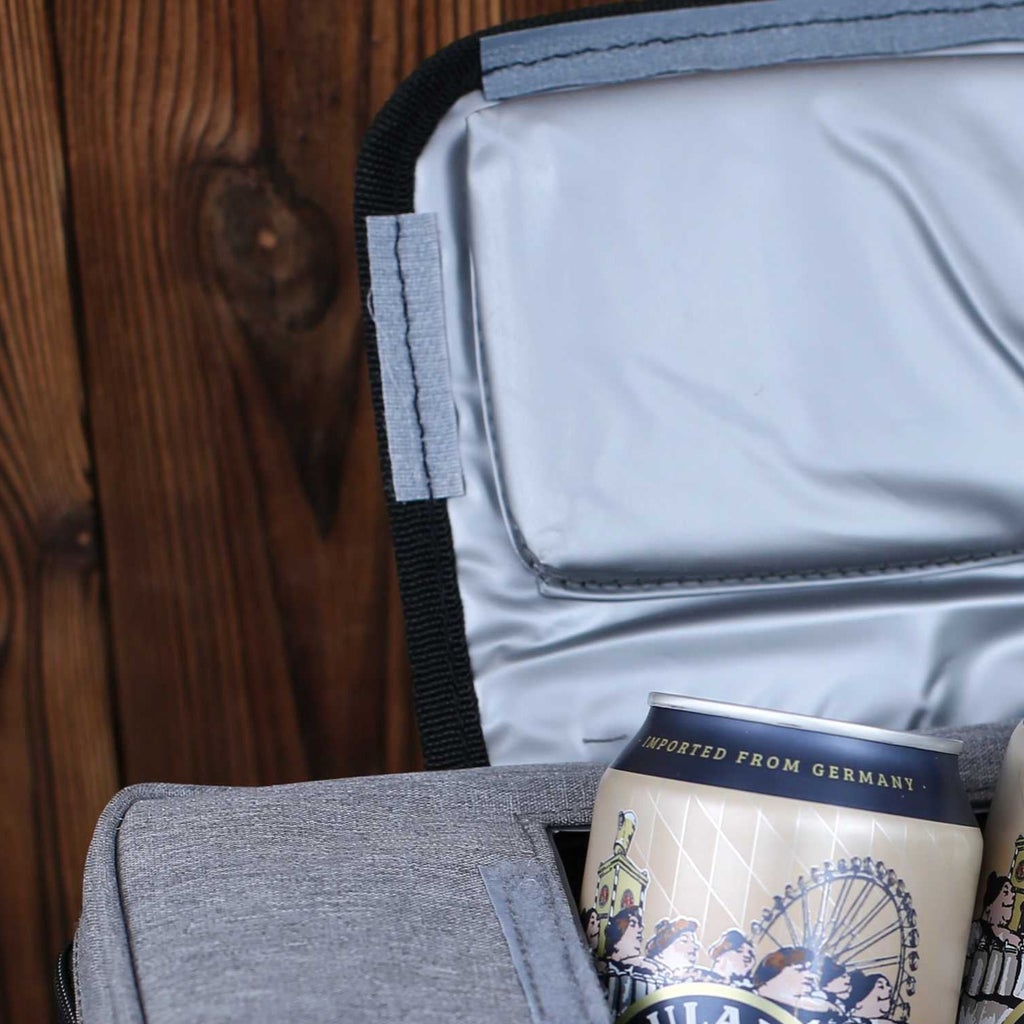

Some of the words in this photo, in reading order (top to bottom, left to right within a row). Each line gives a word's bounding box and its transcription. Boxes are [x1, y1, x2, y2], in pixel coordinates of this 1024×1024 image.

[642, 735, 728, 762] IMPORTED
[735, 750, 800, 774] FROM
[812, 762, 915, 792] GERMANY
